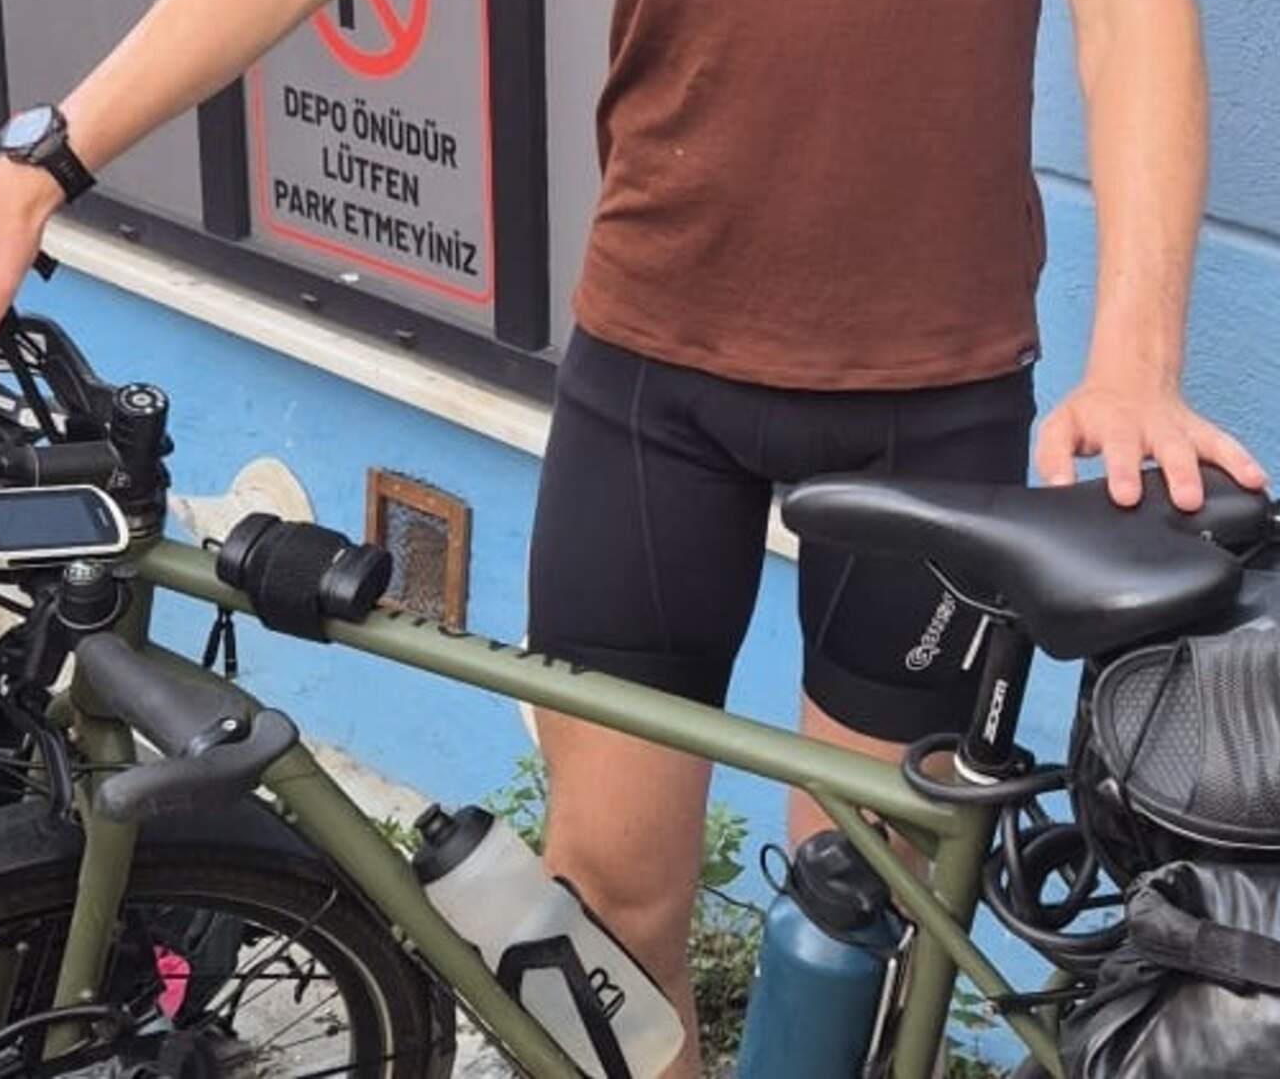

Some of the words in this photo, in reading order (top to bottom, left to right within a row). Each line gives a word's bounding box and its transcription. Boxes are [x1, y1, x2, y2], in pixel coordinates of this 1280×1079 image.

[283, 85, 348, 134] DEPO
[352, 97, 458, 169] ÖNÜDÜR
[321, 141, 420, 207] LÜTFEN
[274, 178, 338, 229] PARK
[342, 202, 478, 276] ETMEYİNİZ
